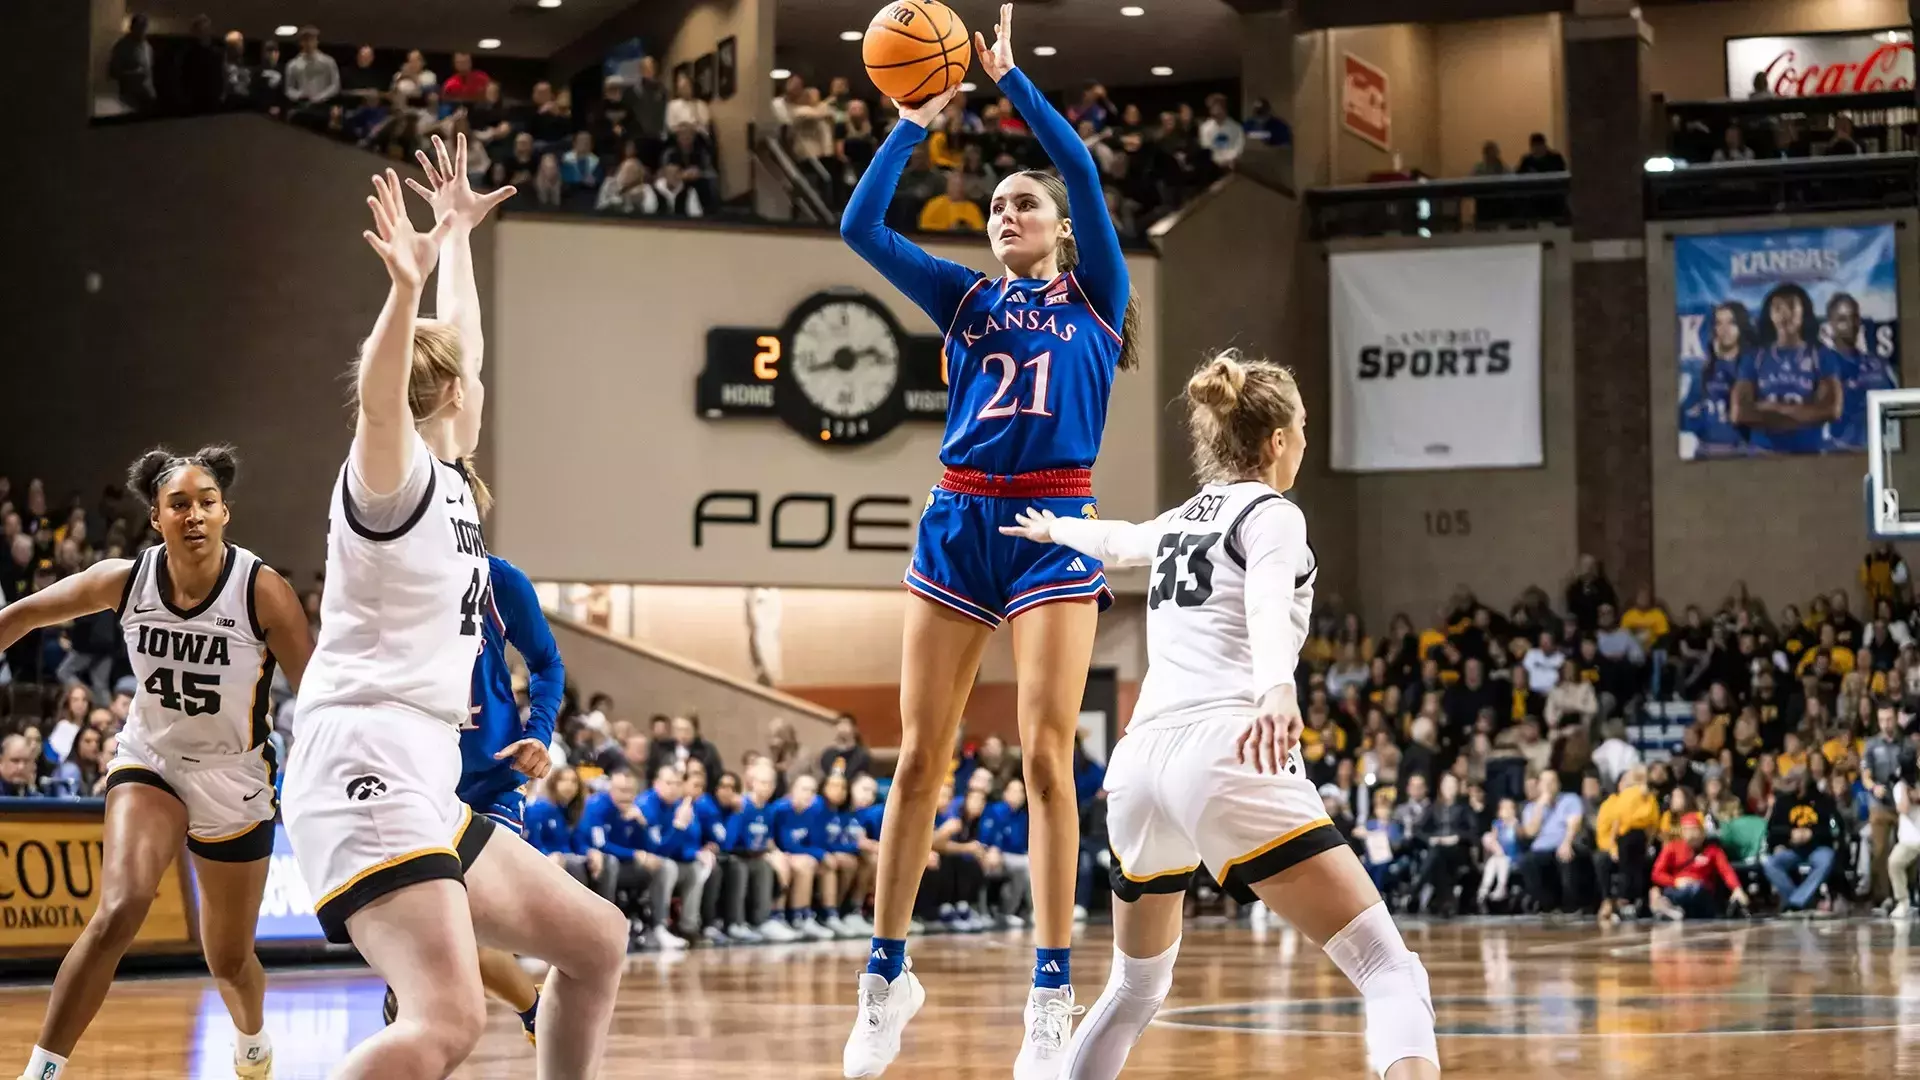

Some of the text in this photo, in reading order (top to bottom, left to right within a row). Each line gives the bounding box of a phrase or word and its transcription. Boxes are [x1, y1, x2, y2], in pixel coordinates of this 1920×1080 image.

[1730, 248, 1840, 277] KANSAS
[961, 309, 1077, 347] KANSAS
[753, 335, 781, 380] 2
[1358, 338, 1512, 381] SPORTS
[721, 384, 775, 407] HOME
[976, 350, 1053, 421] 21
[1424, 509, 1472, 536] 105
[1149, 531, 1223, 611] 33
[136, 624, 231, 667] IOWA
[144, 667, 222, 717] 45
[3, 904, 85, 929] DAKOTA
